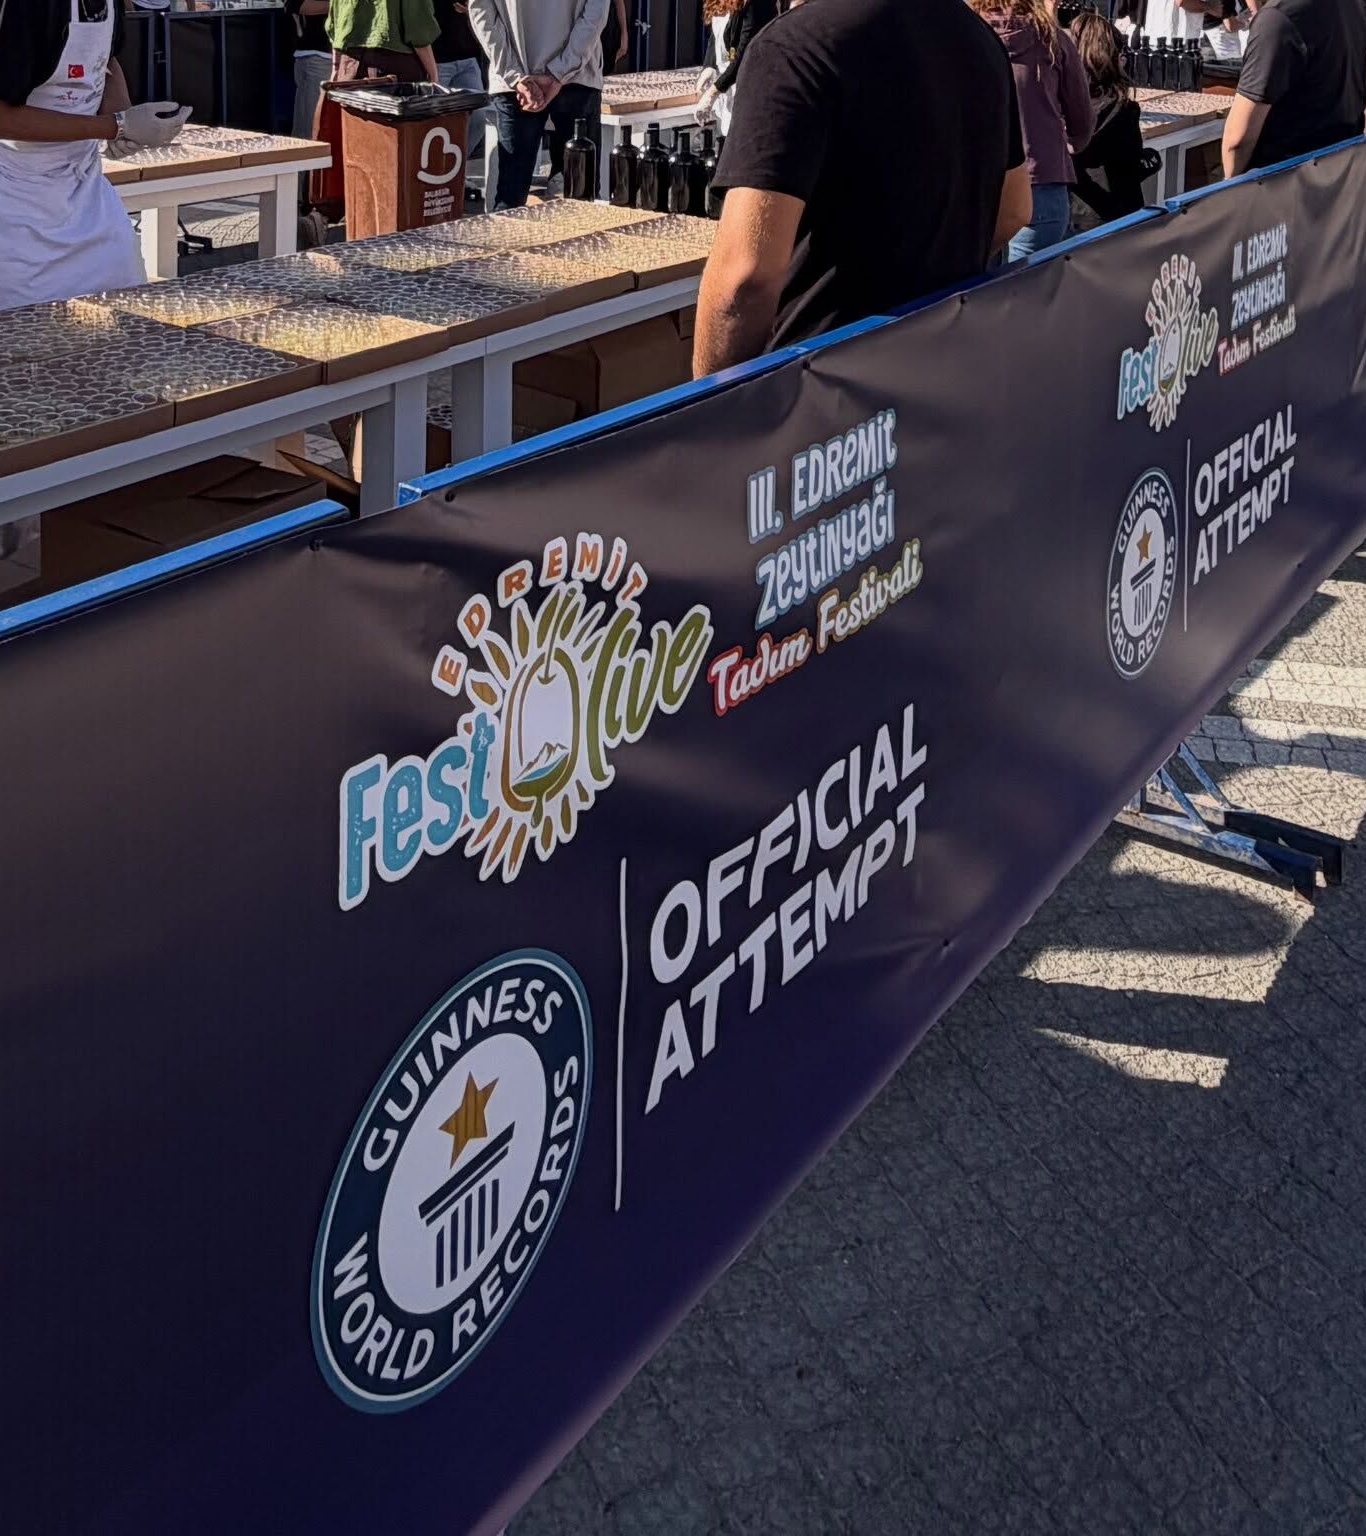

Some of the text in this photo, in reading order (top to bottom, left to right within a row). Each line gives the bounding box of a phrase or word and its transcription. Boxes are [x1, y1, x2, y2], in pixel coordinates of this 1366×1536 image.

[748, 469, 782, 539] III.
[1117, 480, 1171, 554] GUINNESS
[1193, 455, 1295, 586] ATTEMPT
[1194, 404, 1297, 517] OFFICIAL
[710, 542, 922, 712] Tadım Festivali
[1109, 582, 1135, 665] WORLD
[1137, 535, 1175, 664] RECORDS
[649, 703, 928, 984] OFFICIAL
[644, 782, 925, 1115] ATTEMPT
[363, 976, 564, 1172] GUINNESS
[451, 1055, 578, 1353] RECORDS
[333, 1231, 435, 1382] WORLD
